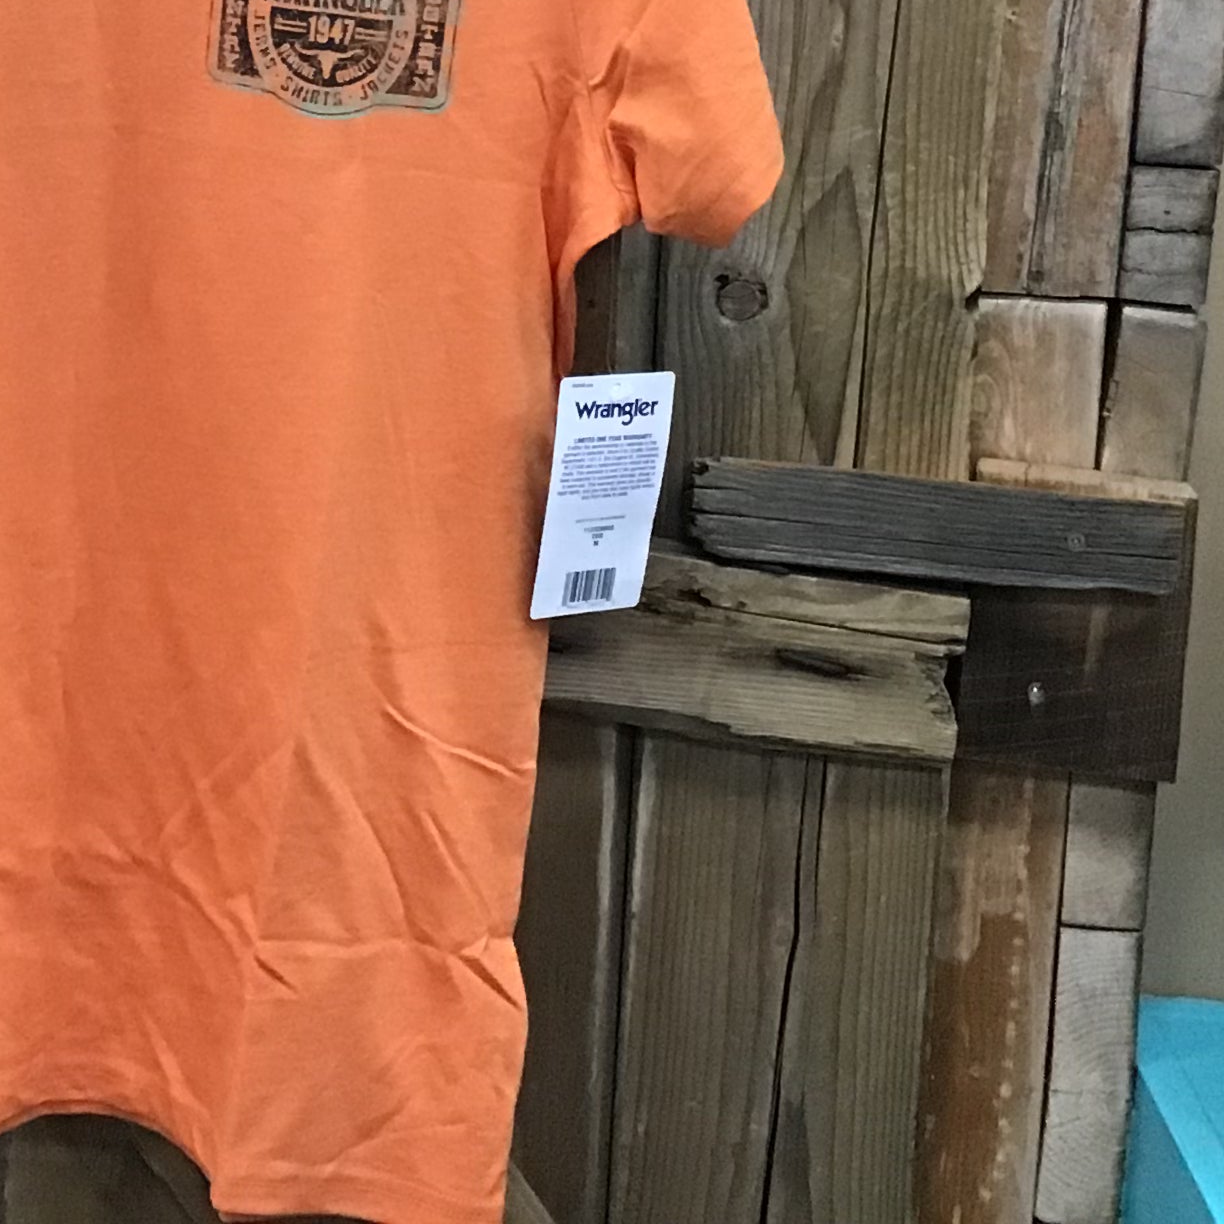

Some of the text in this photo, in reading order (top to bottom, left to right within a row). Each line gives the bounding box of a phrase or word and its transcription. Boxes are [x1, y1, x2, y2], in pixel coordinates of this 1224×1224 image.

[308, 13, 355, 46] 1947
[280, 76, 343, 107] SHIRTS
[359, 29, 409, 101] JACKETS
[575, 398, 659, 426] Wrangler
